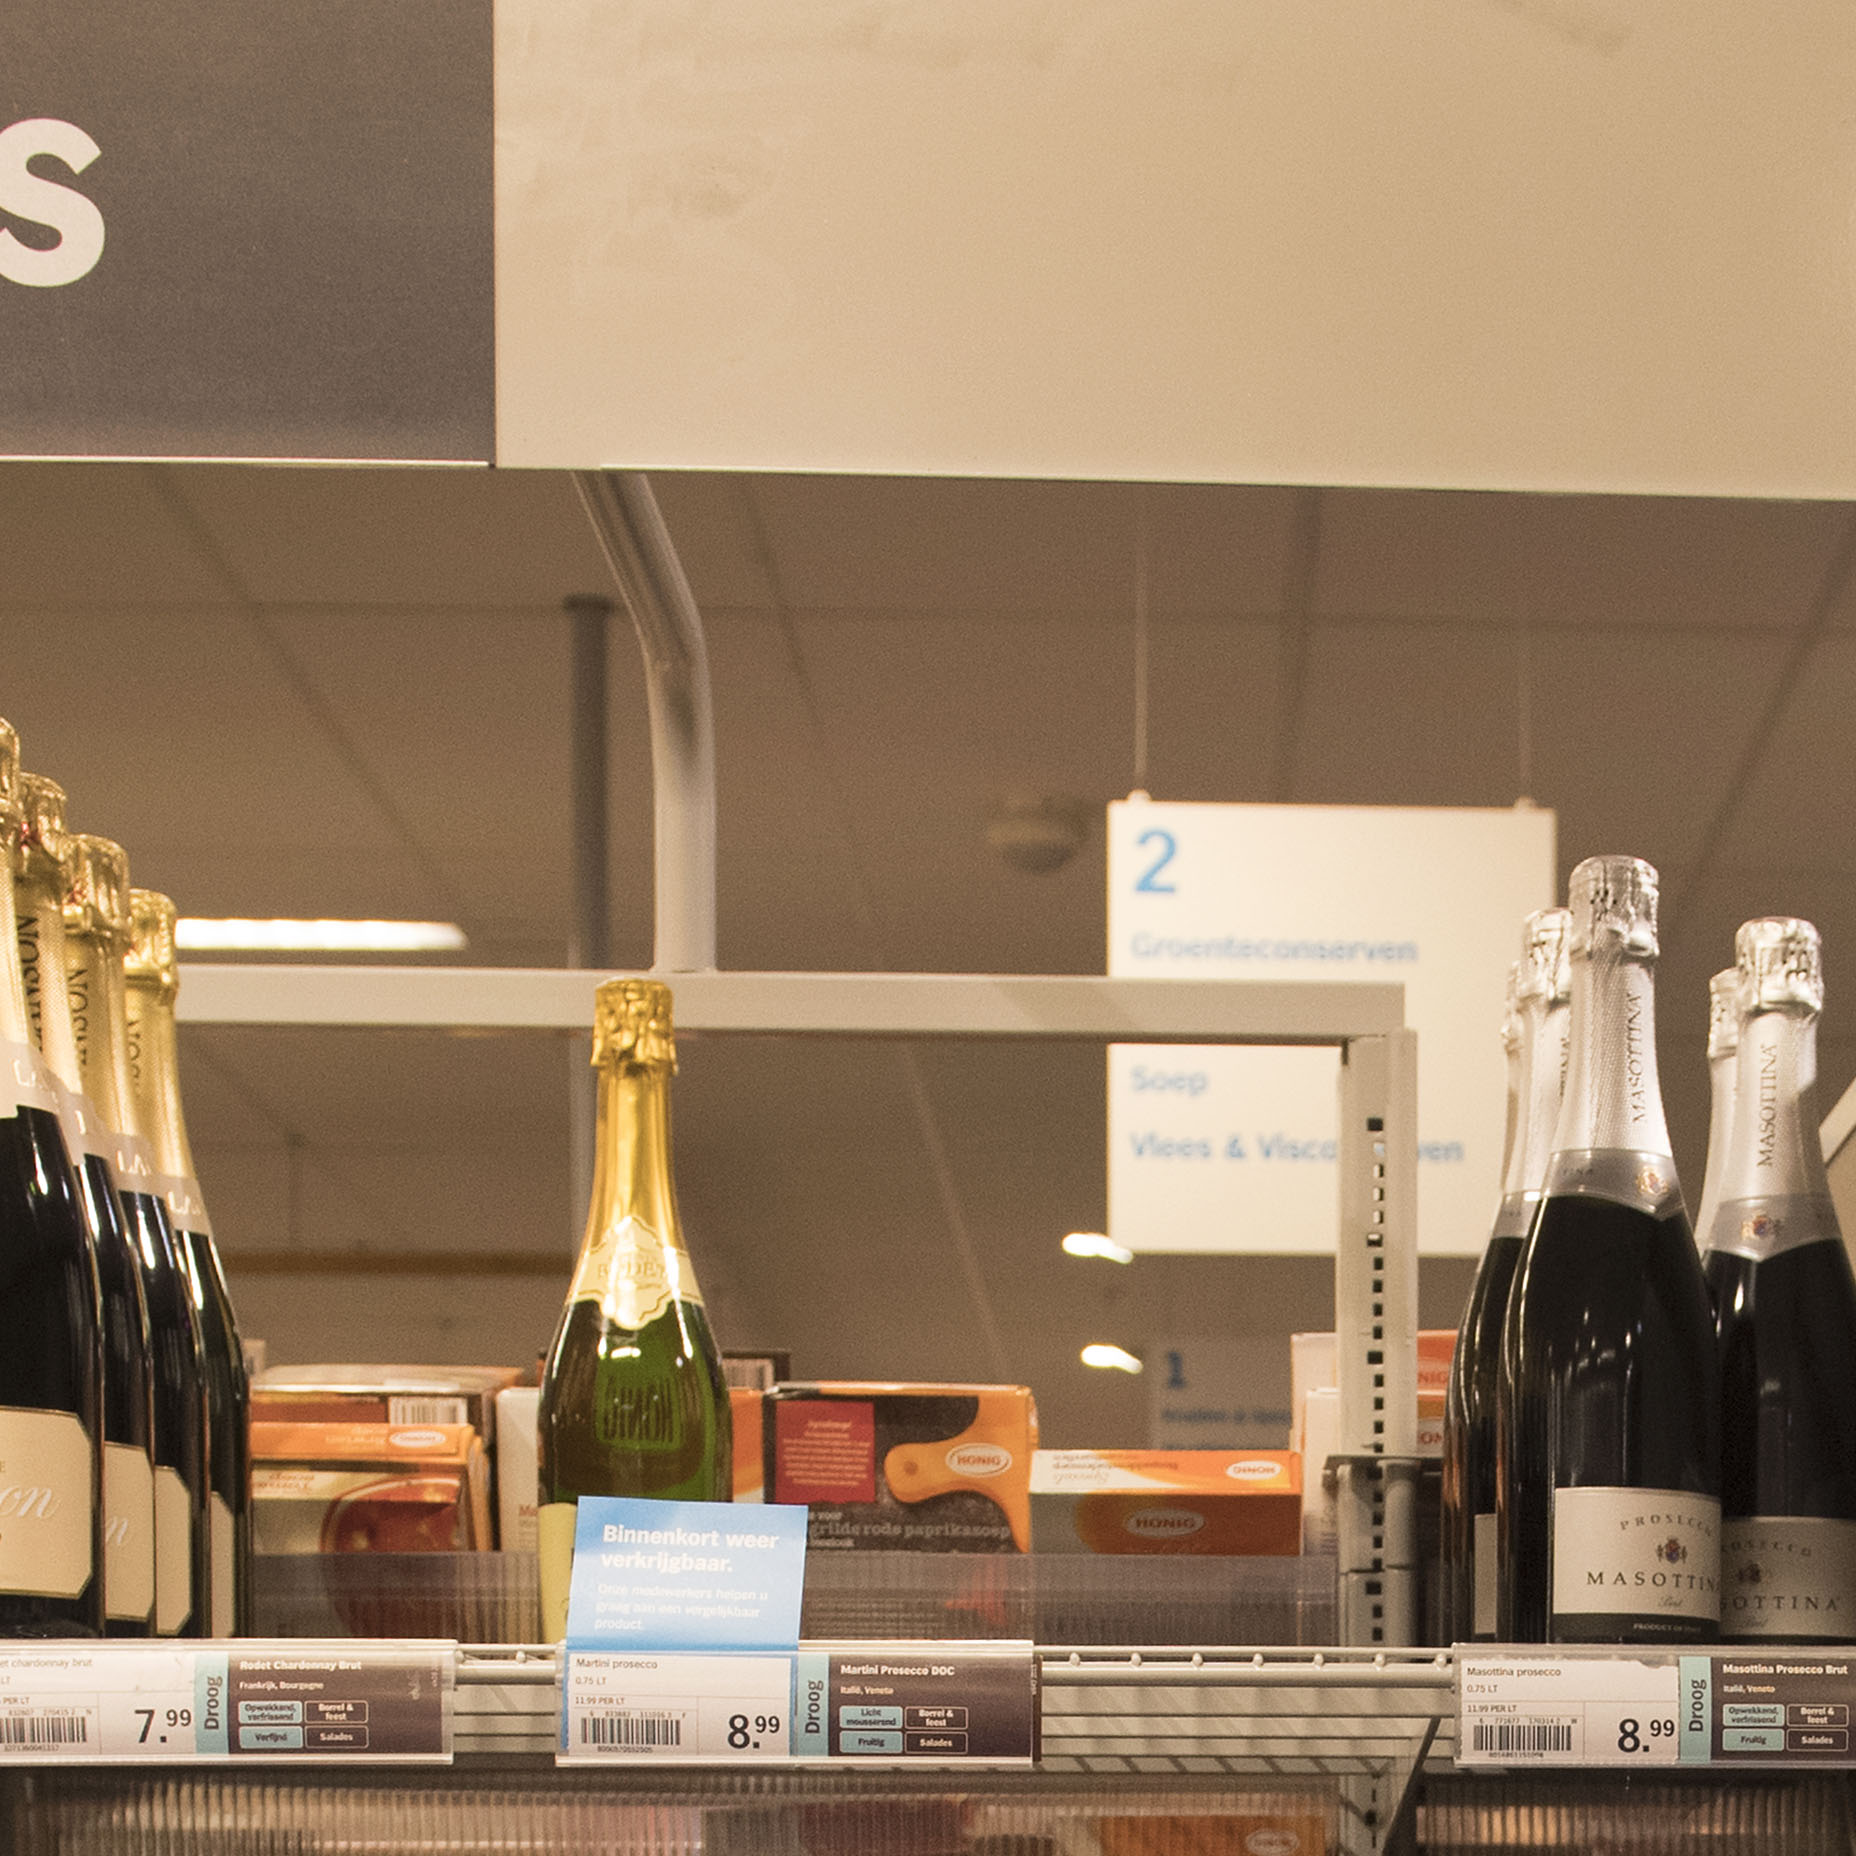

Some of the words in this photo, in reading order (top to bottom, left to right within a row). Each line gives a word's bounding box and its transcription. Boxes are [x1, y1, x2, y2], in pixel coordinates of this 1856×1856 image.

[1135, 828, 1176, 894] 2
[1131, 932, 1418, 966] Groenteconserven
[1131, 1066, 1208, 1096] Soep
[1757, 1042, 1778, 1168] MASOTTINA
[1130, 1133, 1212, 1160] Vlees
[1225, 1137, 1245, 1159] &
[957, 1452, 1001, 1469] HONIG
[603, 1524, 719, 1548] Binnenkort
[727, 1532, 780, 1551] weer
[601, 1551, 733, 1574] verkrijgbaar.
[840, 1664, 878, 1677] Martini
[881, 1665, 927, 1678] Prosecco
[931, 1666, 955, 1677] DOC
[204, 1677, 221, 1731] Droog
[806, 1680, 822, 1735] Droog
[1689, 1679, 1705, 1733] Droog
